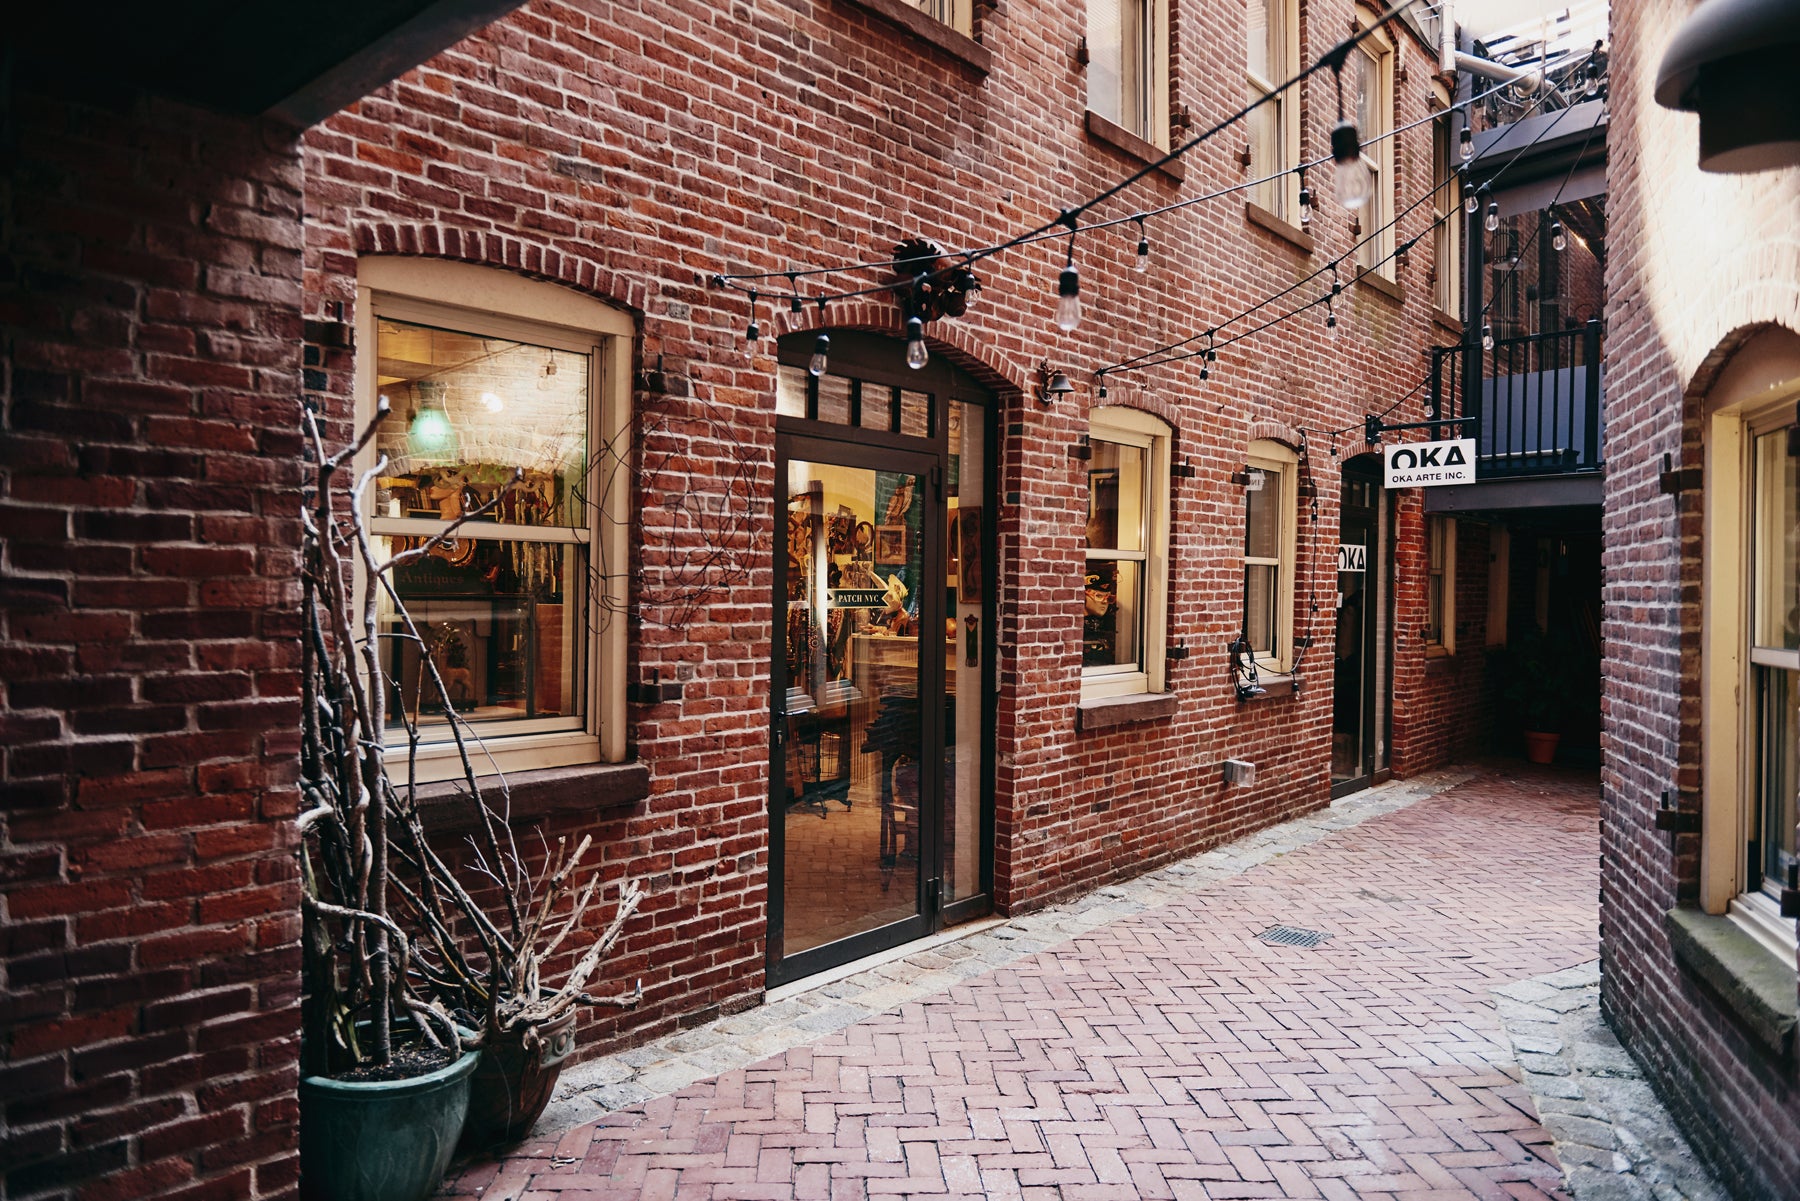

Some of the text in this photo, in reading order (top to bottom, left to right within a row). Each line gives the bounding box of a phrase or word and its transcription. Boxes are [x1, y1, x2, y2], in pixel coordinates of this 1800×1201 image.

[1391, 446, 1466, 470] OKA
[1392, 471, 1466, 483] OKA ARTE INC.
[1337, 546, 1365, 570] OKA
[401, 571, 465, 586] Antiques
[838, 594, 879, 603] PATCH NYC
